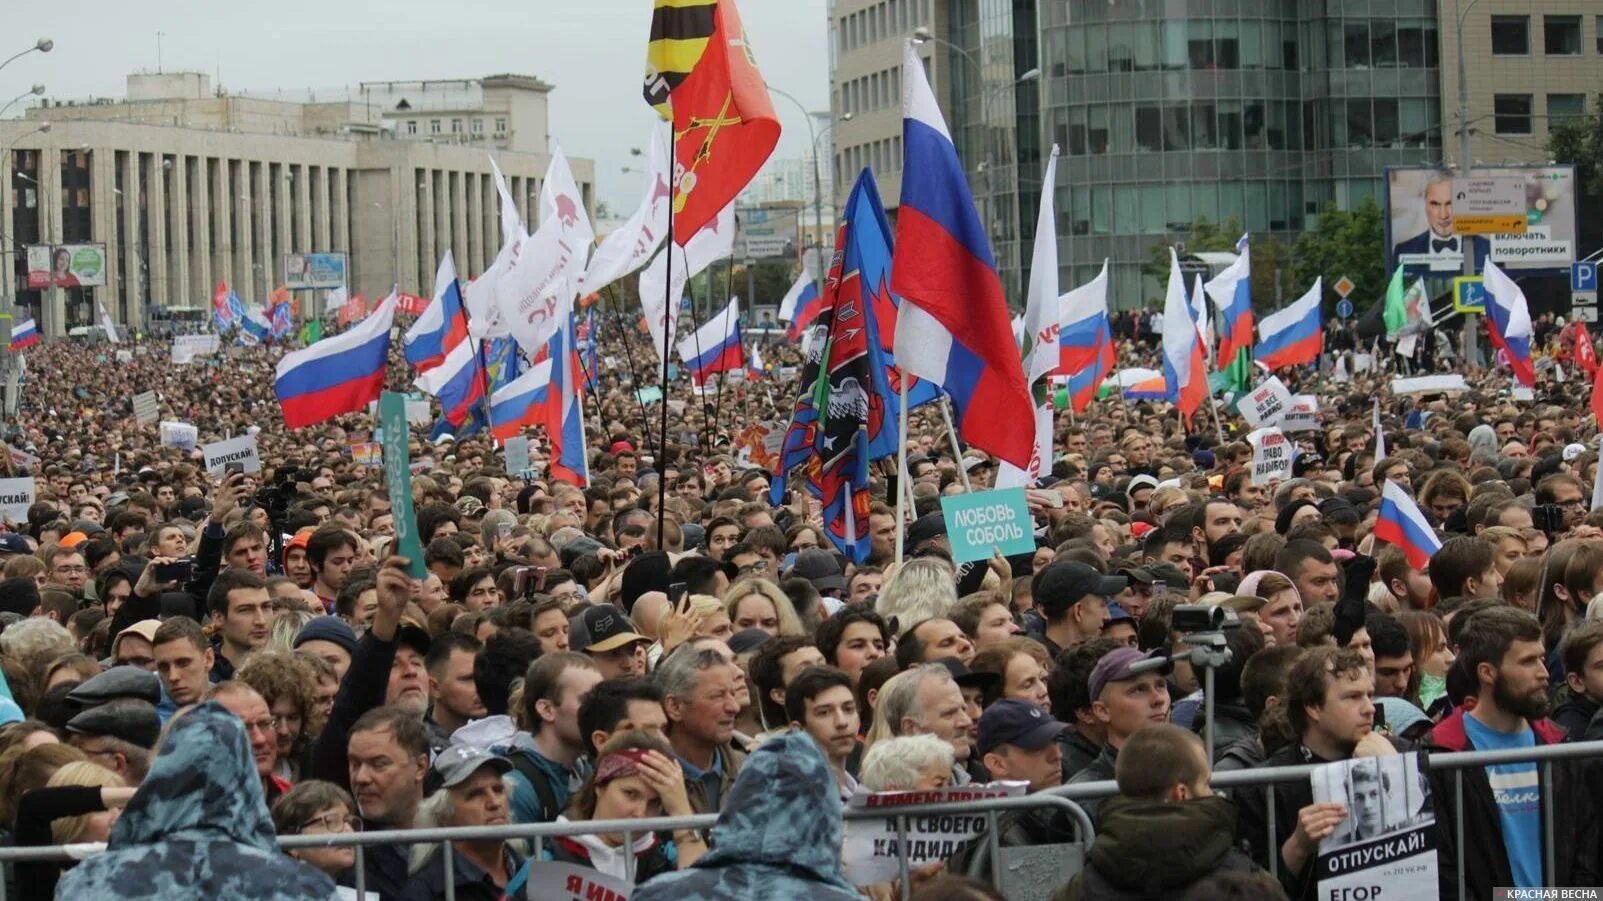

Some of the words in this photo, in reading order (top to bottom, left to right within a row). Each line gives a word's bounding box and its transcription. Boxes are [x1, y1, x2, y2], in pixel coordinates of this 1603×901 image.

[1495, 246, 1567, 256] поворотники
[210, 448, 254, 468] ДОПУСКАЙ!
[1263, 446, 1282, 460] ПРАВО
[0, 492, 30, 504] СКАЙ!
[955, 503, 1015, 528] ЛЮБОВЬ
[966, 523, 1023, 546] СОБОЛЬ
[916, 816, 985, 834] СВОЕГО
[1328, 832, 1425, 872] ОТПУСКАЙ!
[566, 874, 583, 895] Я
[1330, 886, 1382, 901] ЕГОР
